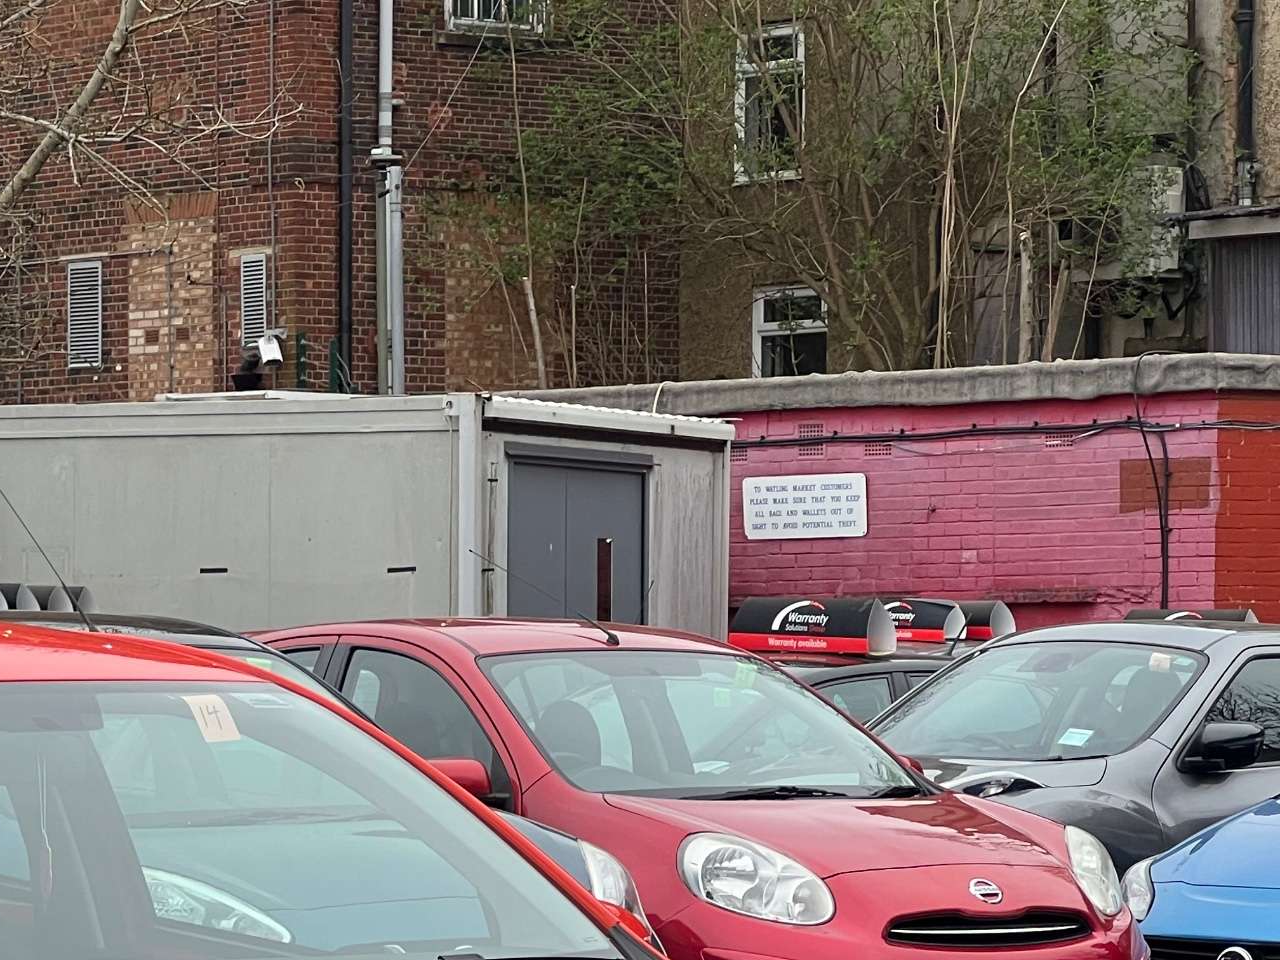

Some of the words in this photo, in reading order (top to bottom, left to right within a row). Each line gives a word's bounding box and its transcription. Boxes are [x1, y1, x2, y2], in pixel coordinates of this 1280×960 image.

[802, 520, 833, 529] POTENTIAL
[788, 612, 829, 626] Warranty
[785, 623, 808, 632] Solutions
[768, 637, 797, 649] Warranty
[797, 639, 828, 649] available
[199, 704, 223, 730] 14
